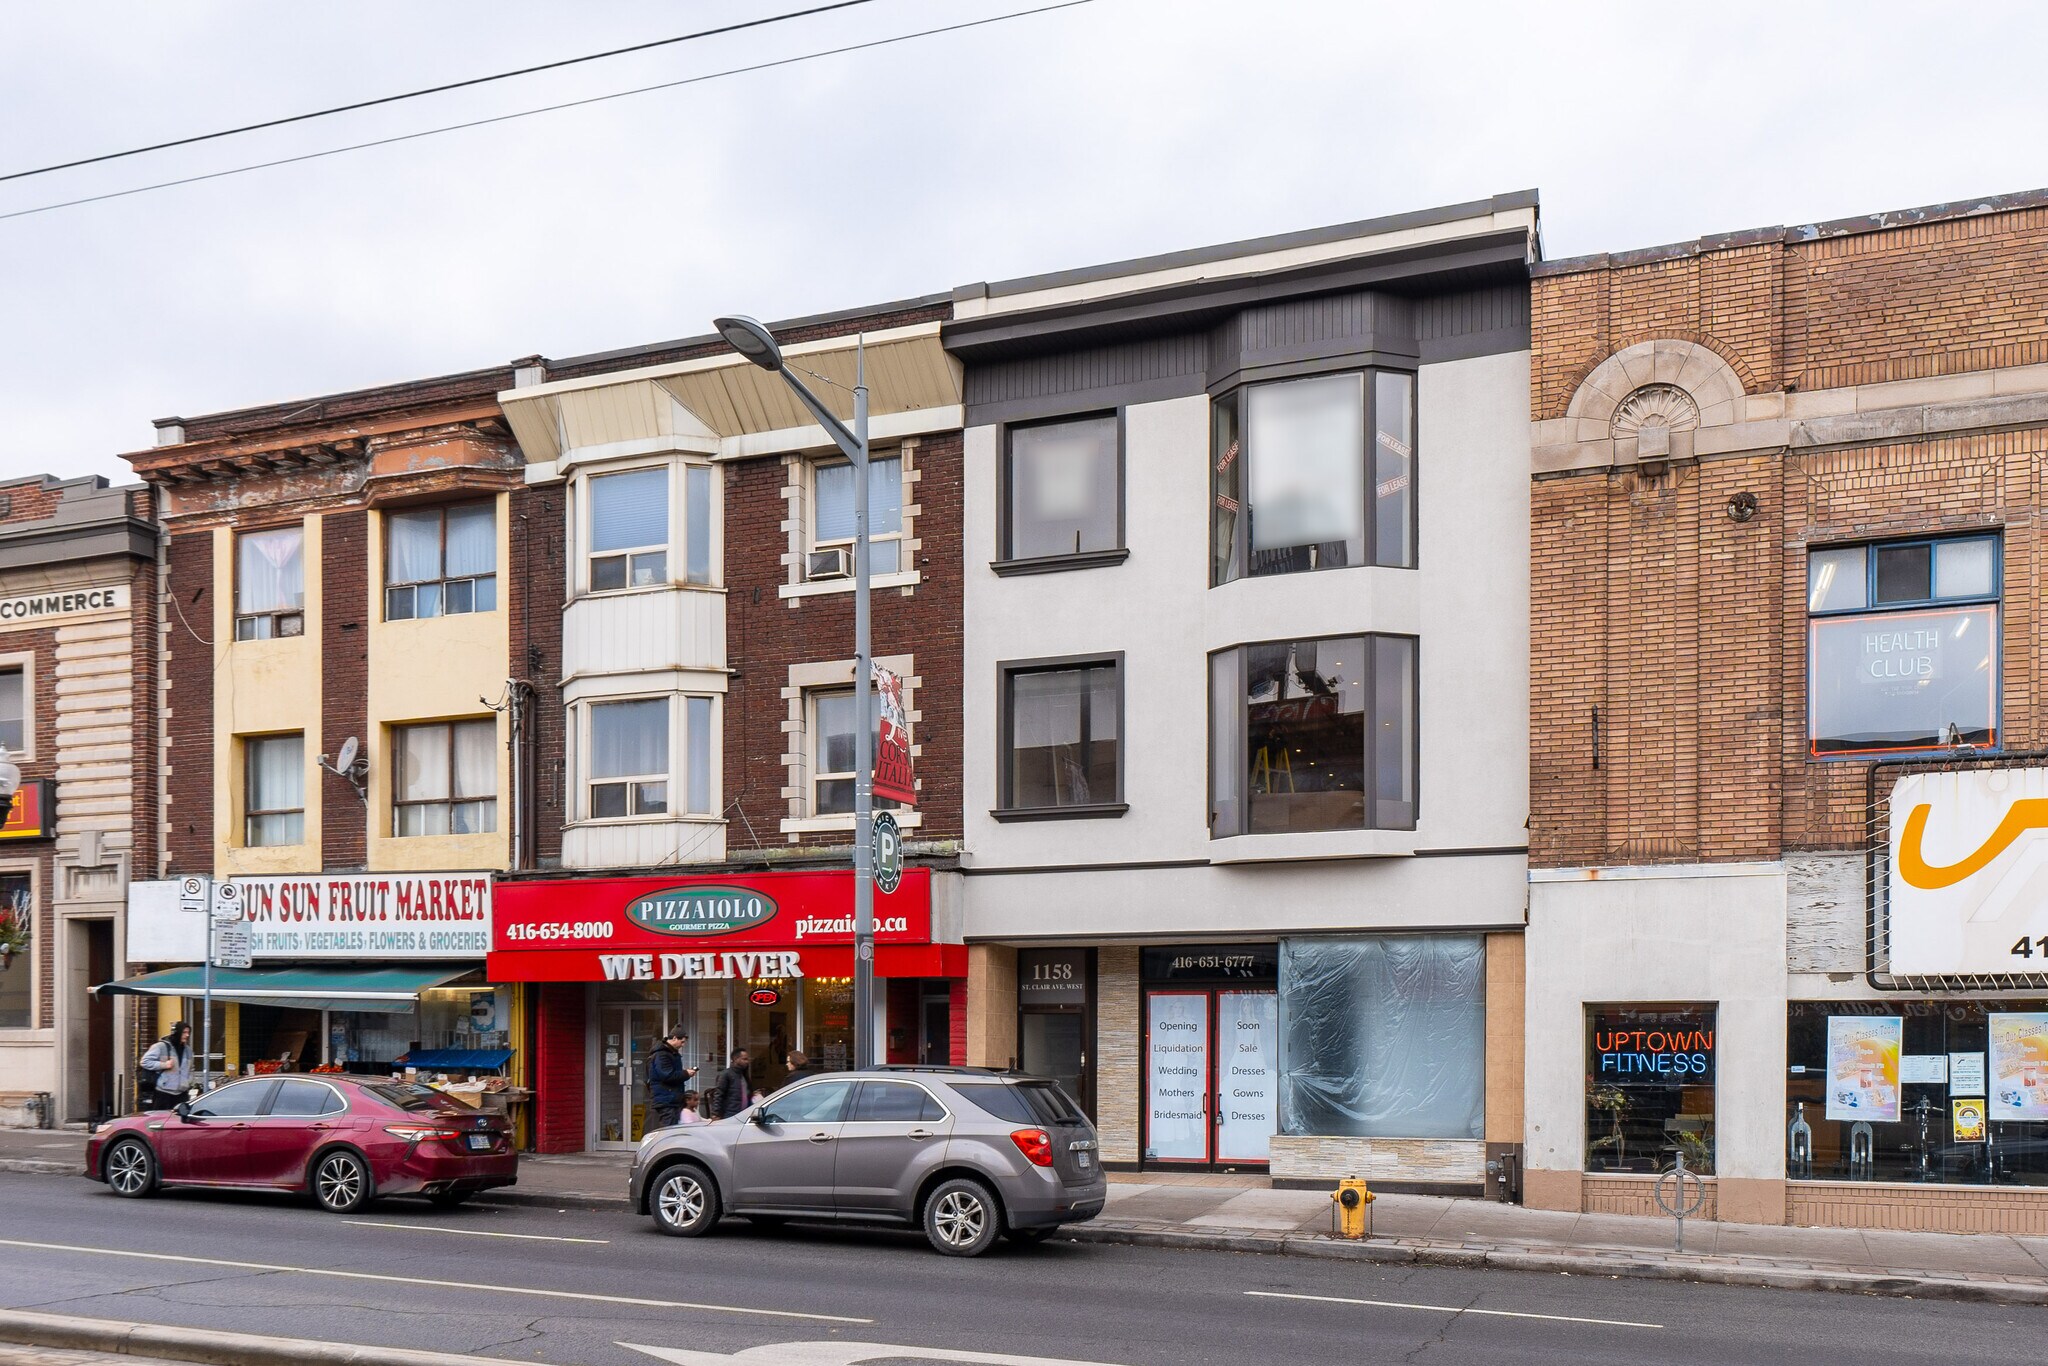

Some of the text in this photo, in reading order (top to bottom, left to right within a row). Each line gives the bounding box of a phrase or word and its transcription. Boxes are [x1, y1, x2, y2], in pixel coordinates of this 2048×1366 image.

[1217, 441, 1239, 473] FOR LEASE
[1390, 440, 1410, 457] LEASE
[1377, 476, 1409, 496] FOR LEASE
[1217, 495, 1238, 512] FOR LEASE
[0, 590, 115, 619] COMMERCE
[1866, 631, 1939, 654] HEALTH
[1870, 656, 1934, 678] CLUB
[279, 882, 321, 922] SUN
[328, 881, 390, 921] FRUIT
[395, 879, 487, 921] MARKET
[641, 898, 762, 921] PIZZAIOLO
[506, 921, 613, 940] 416-654-8000
[669, 922, 730, 931] GOURMET PIZZA
[369, 931, 415, 951] FLOWERS
[418, 931, 426, 951] &
[429, 931, 488, 951] GROCERIES
[598, 951, 805, 981] WE DELIVER
[1033, 963, 1073, 980] 1158
[1172, 955, 1255, 969] 416-651-6777
[752, 992, 777, 1002] OPEN
[1159, 1021, 1260, 1032] Opening Soon
[1856, 1028, 1879, 1042] Classes
[1880, 1023, 1898, 1036] Today
[2018, 1026, 2042, 1039] Classes
[1154, 1043, 1258, 1054] Liquidation Sale
[1596, 1031, 1713, 1052] UPTOWN
[1158, 1066, 1266, 1077] Wedding Dresses
[1602, 1053, 1706, 1073] FITNESS
[1158, 1088, 1264, 1098] Mothers Gowns
[1154, 1110, 1266, 1120] Bridesmaid Dresses
